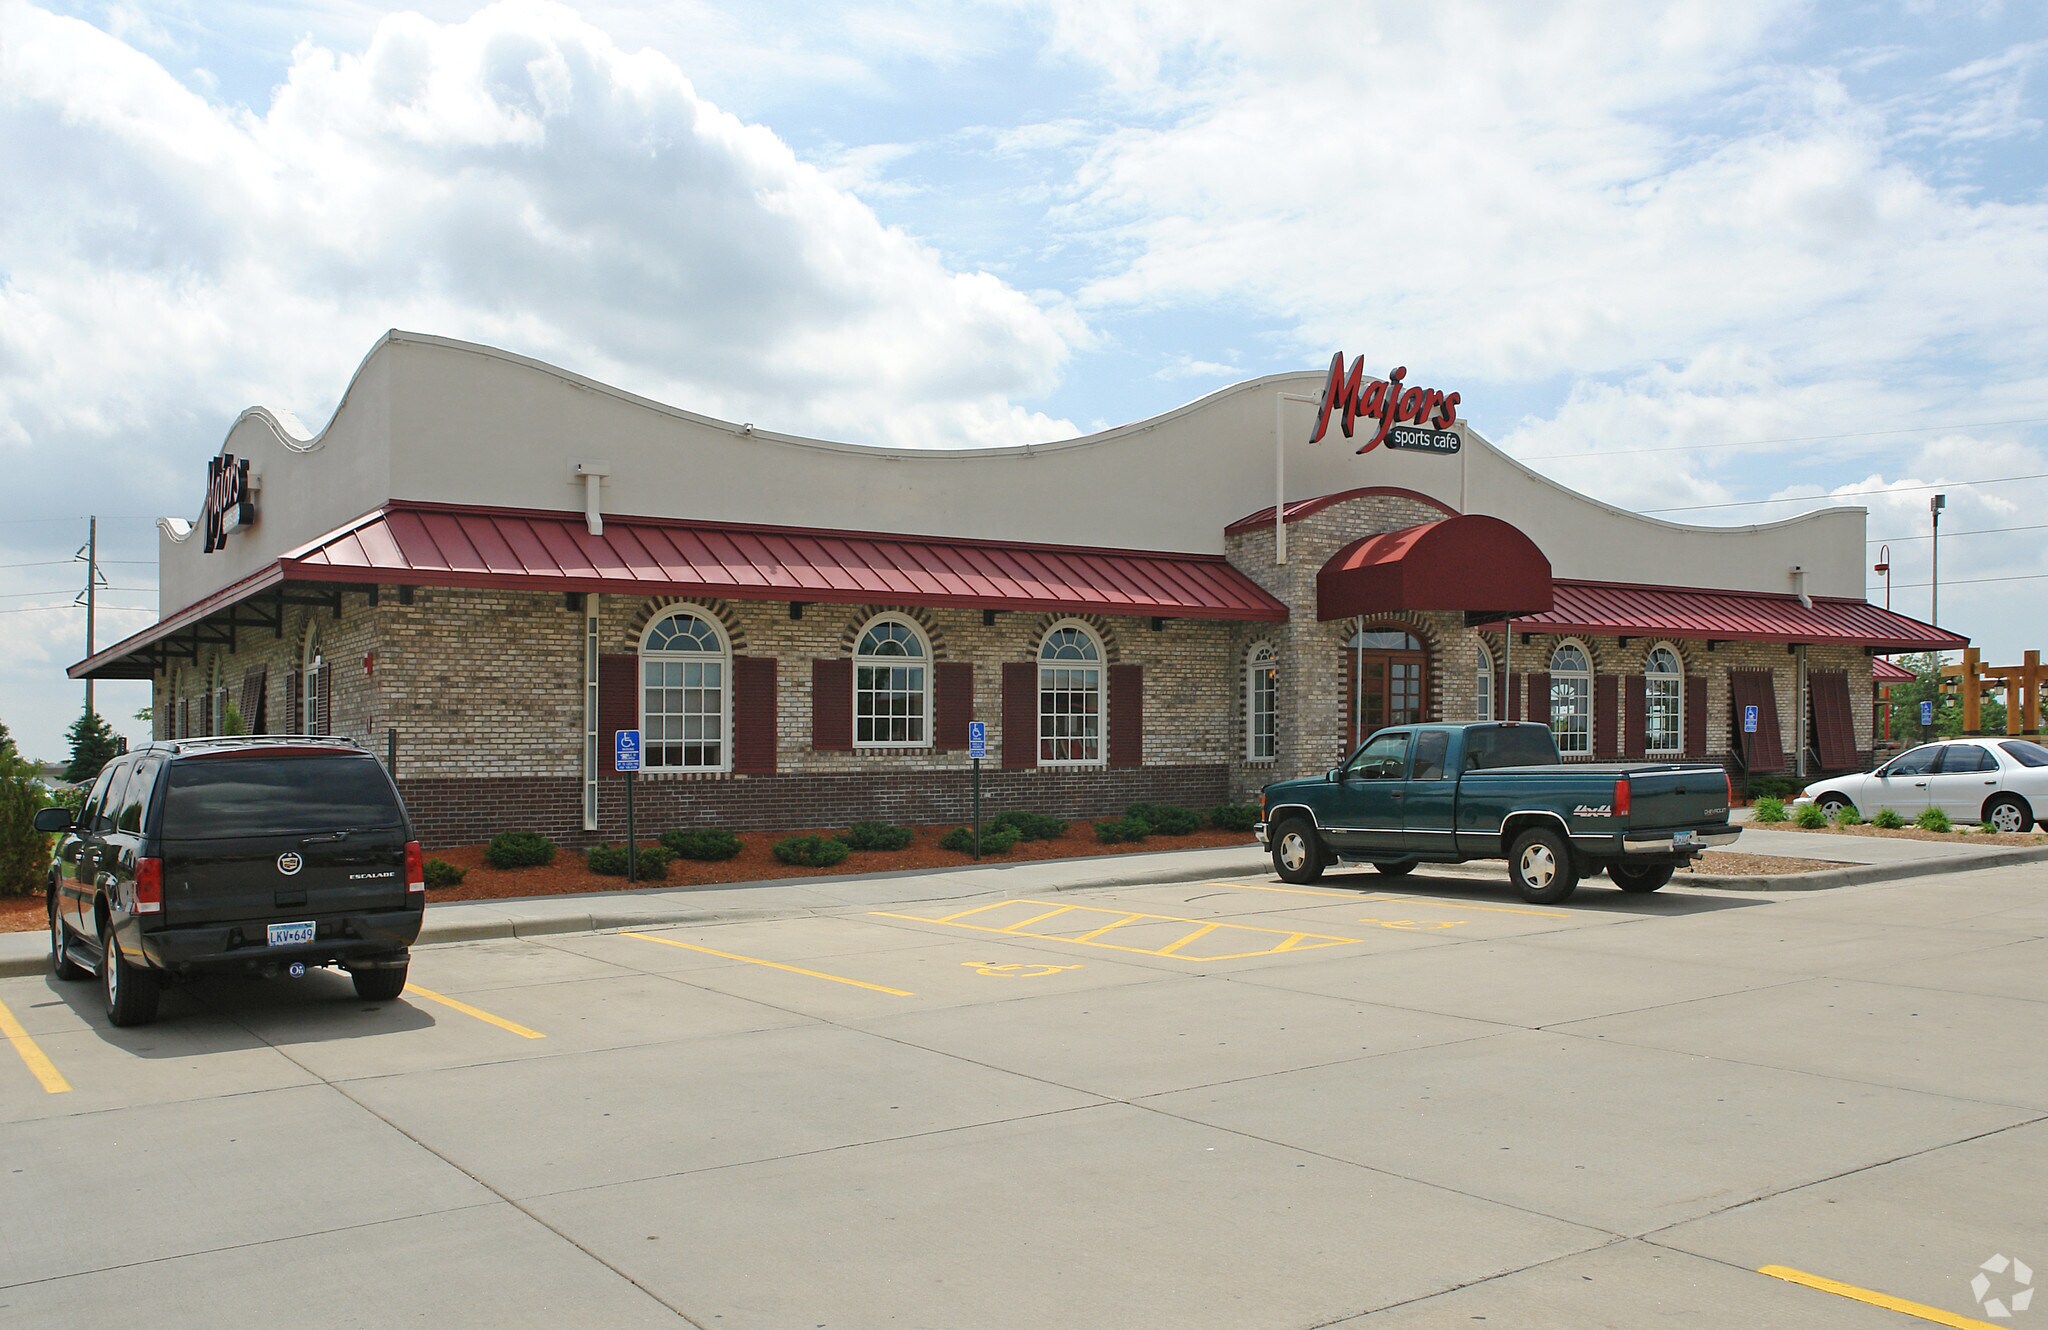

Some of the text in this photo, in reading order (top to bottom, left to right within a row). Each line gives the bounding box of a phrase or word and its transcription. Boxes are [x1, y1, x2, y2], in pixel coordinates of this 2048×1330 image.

[1309, 350, 1461, 455] Majors
[1394, 430, 1458, 449] sports cafe
[349, 871, 396, 880] ESCALADE
